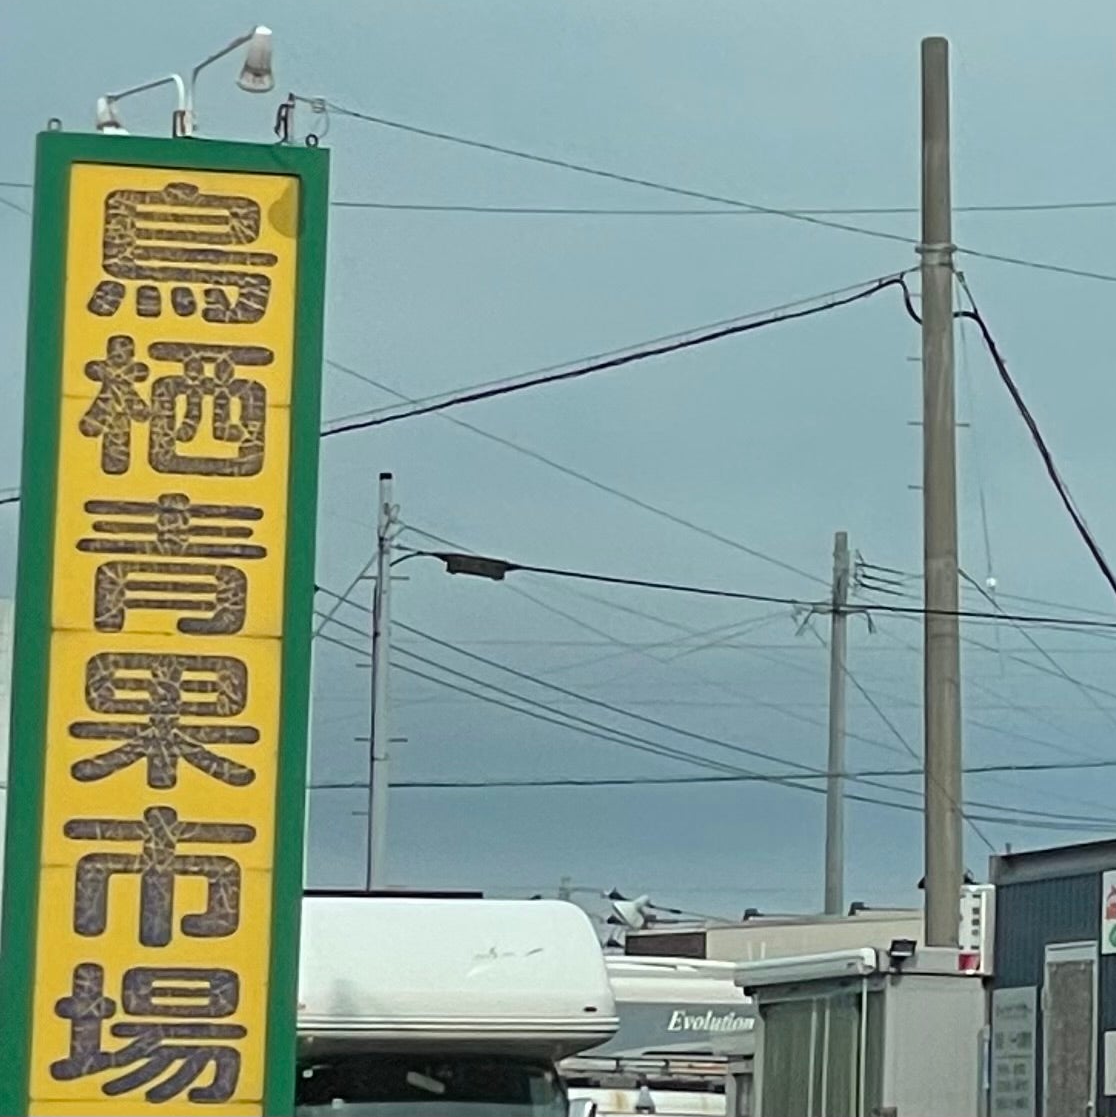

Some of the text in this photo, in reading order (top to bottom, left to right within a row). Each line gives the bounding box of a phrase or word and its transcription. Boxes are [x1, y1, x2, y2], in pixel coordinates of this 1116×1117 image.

[50, 182, 278, 1104] 鳥栖青果市場
[667, 1010, 755, 1032] Evolution
